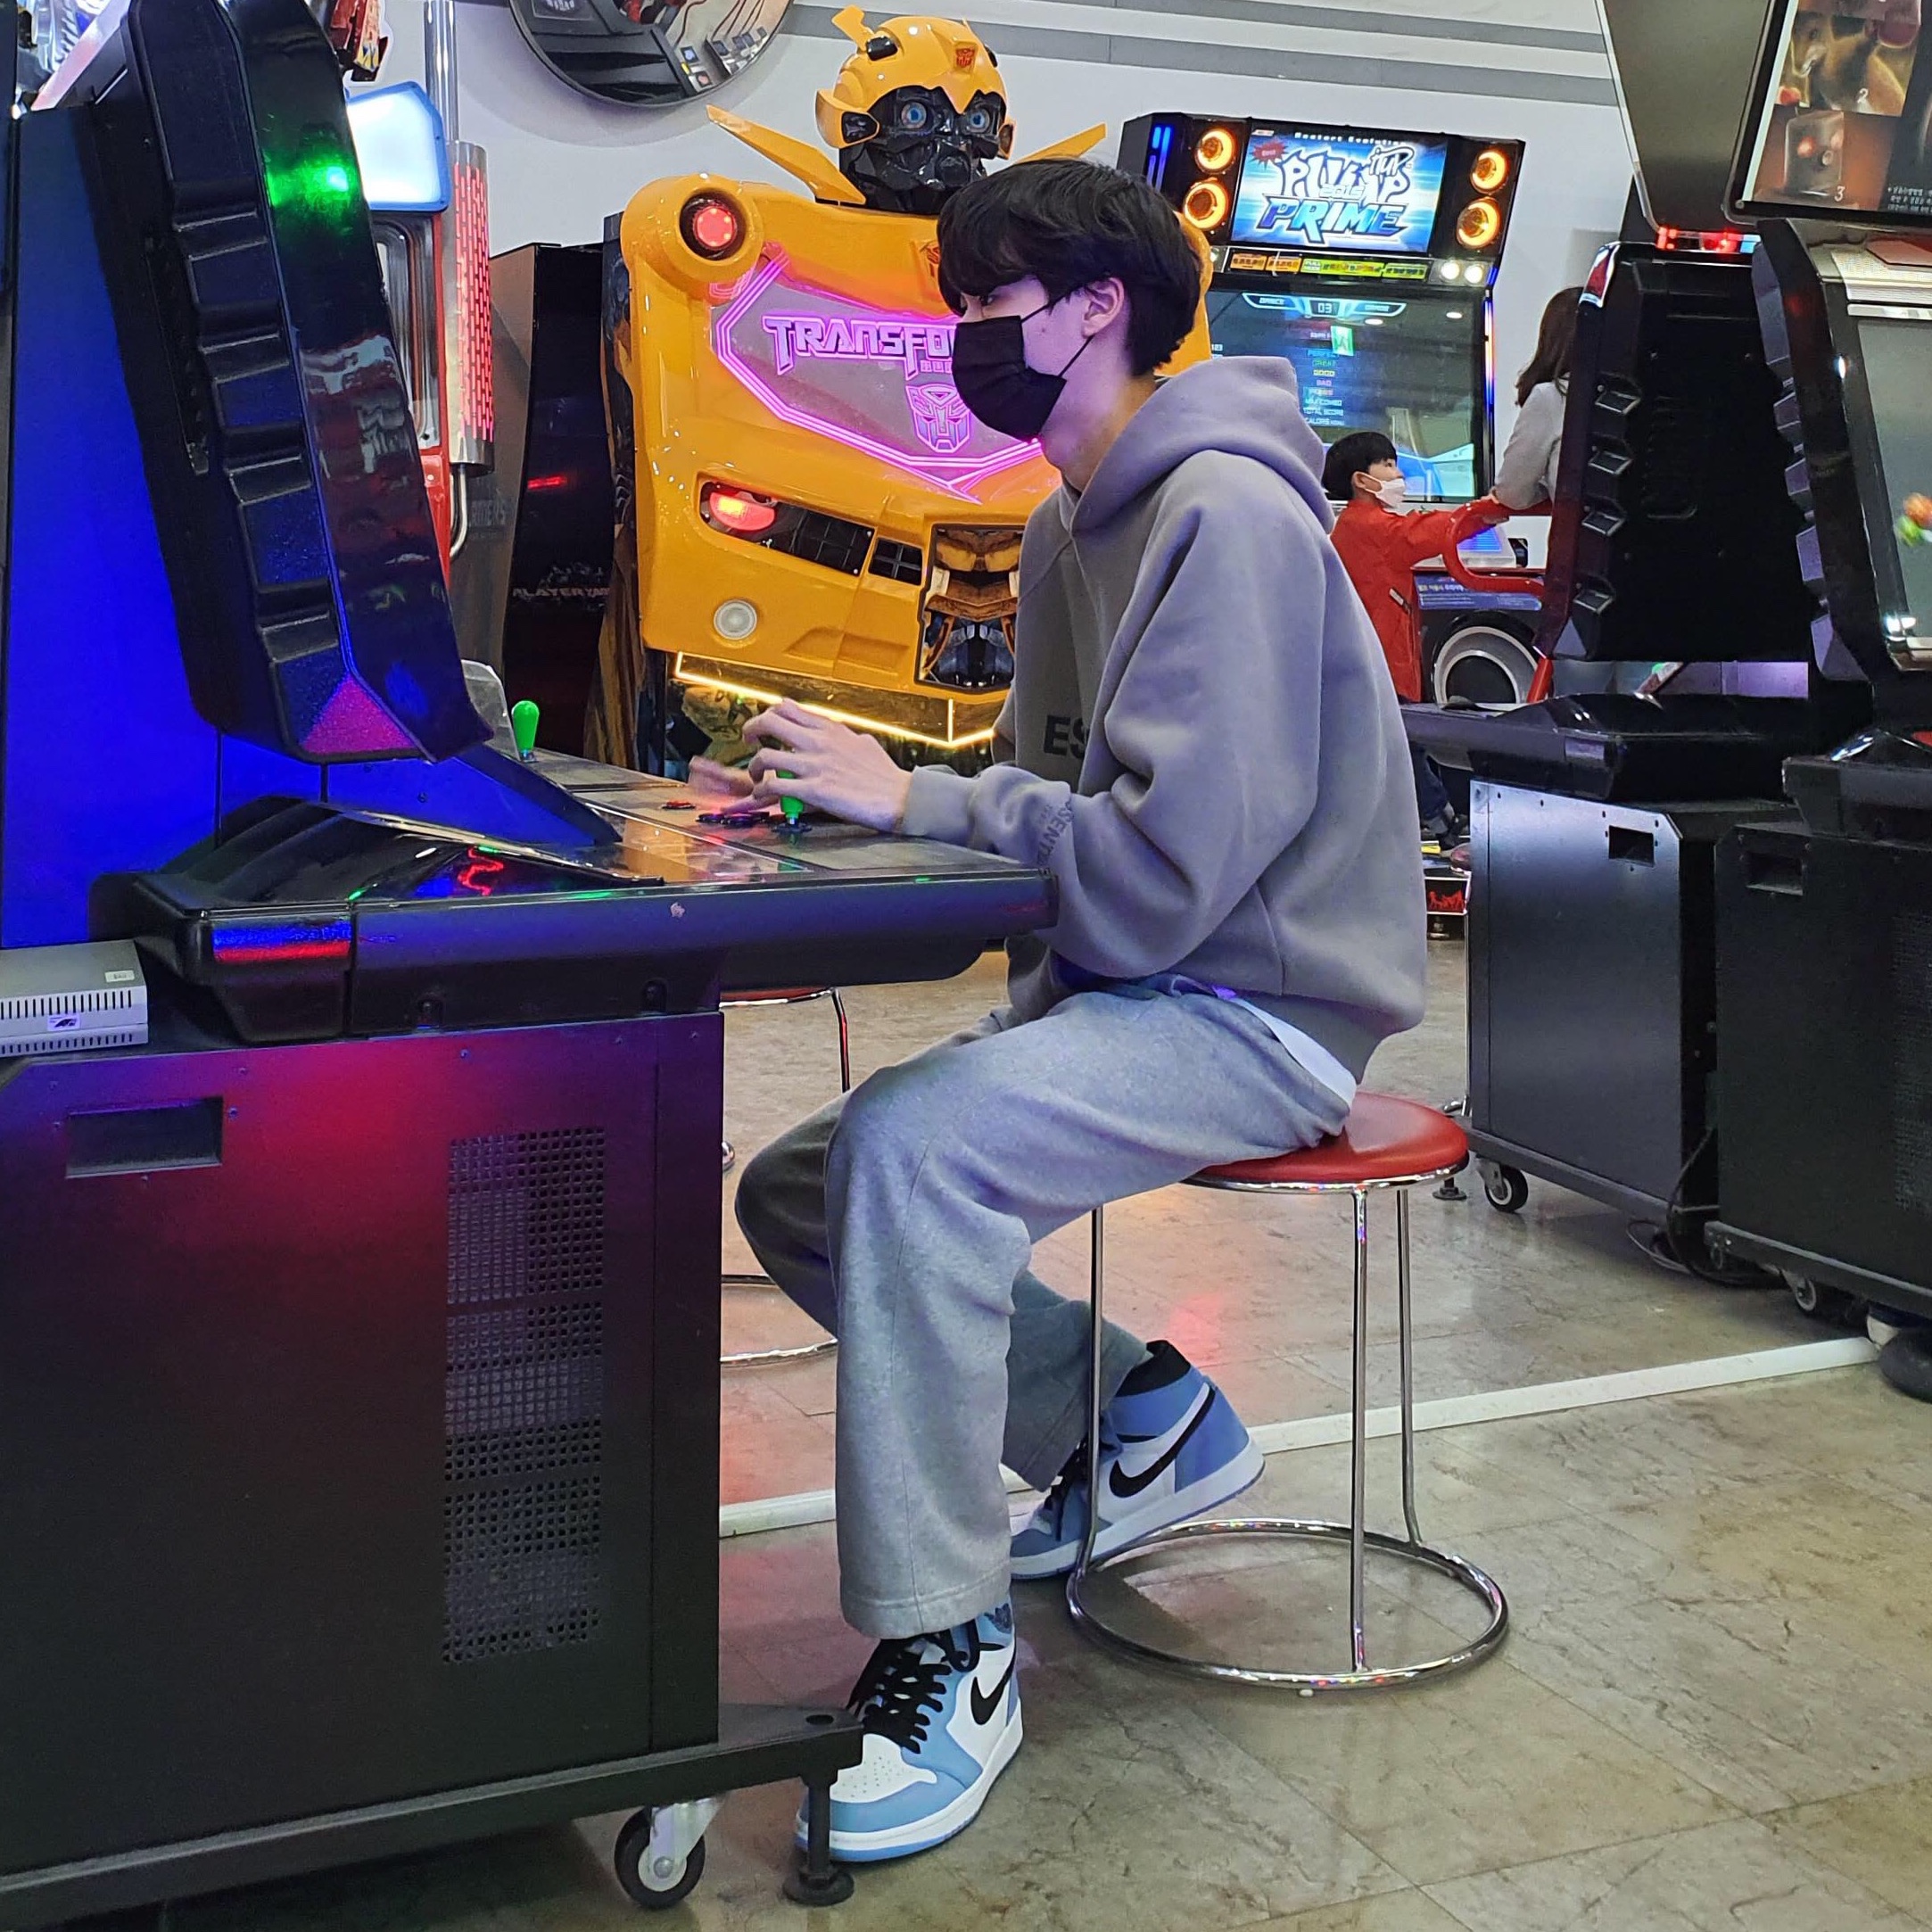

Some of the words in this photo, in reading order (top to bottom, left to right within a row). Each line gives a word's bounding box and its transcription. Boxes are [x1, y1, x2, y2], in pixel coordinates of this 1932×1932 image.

[1834, 186, 1846, 202] 3
[1256, 194, 1410, 244] PRIME
[1317, 302, 1333, 313] 03
[763, 316, 955, 382] TRANSFO
